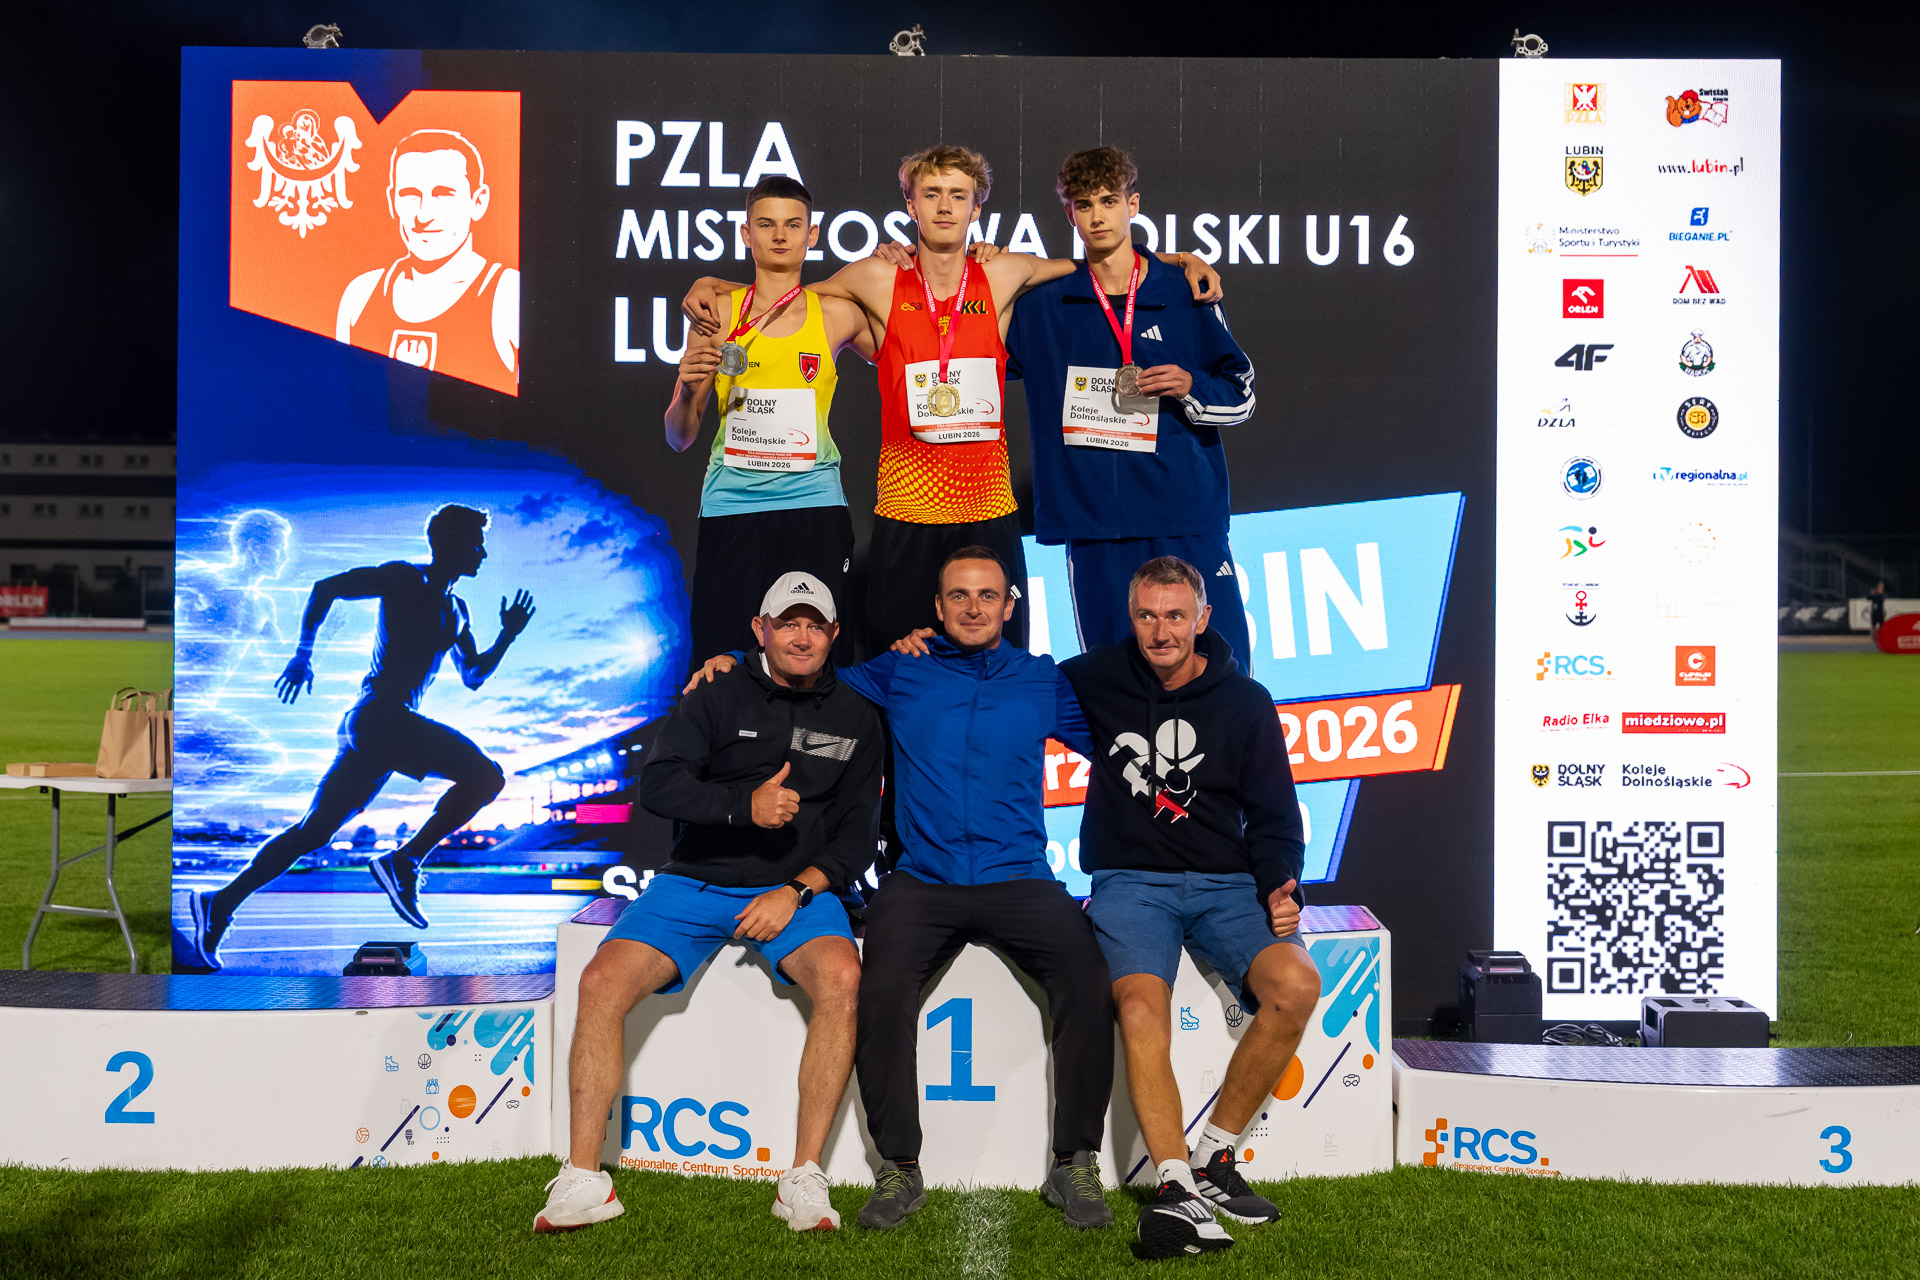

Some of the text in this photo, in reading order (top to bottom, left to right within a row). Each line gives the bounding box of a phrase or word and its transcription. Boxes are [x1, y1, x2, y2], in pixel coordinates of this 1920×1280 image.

[616, 120, 805, 187] PZLA
[1565, 146, 1604, 155] LUBIN
[1658, 157, 1744, 176] www.lubin.pl
[1306, 214, 1415, 266] U16
[1559, 238, 1590, 247] Sportu
[1599, 238, 1640, 247] Turystyki
[1668, 232, 1730, 241] BIEGANIE.PL
[1568, 305, 1599, 314] ORLEN
[1554, 344, 1615, 371] 4F
[1091, 377, 1115, 386] DOLN
[747, 398, 777, 407] DOLNY
[1070, 404, 1099, 415] Koleje
[1070, 411, 1127, 424] Dolnośląskie
[1537, 418, 1575, 427] DZLA
[732, 426, 757, 437] Koleje
[938, 432, 961, 440] LUBIN
[731, 433, 786, 446] Dolnośląskie
[1086, 436, 1130, 448] LUBIN 2026
[748, 460, 791, 469] LUBIN 2026
[1543, 713, 1610, 727] Radio Elka
[1625, 714, 1723, 729] miedziowe.pl
[1281, 699, 1418, 765] 2026
[1558, 764, 1606, 775] DOLNY
[1622, 764, 1666, 776] Koleje
[1622, 776, 1713, 789] Dolnośląskie
[925, 997, 996, 1102] 1
[104, 1050, 156, 1124] 2
[1819, 1125, 1853, 1174] 3
[620, 1156, 678, 1172] Regionalne
[682, 1161, 729, 1176] Centrum
